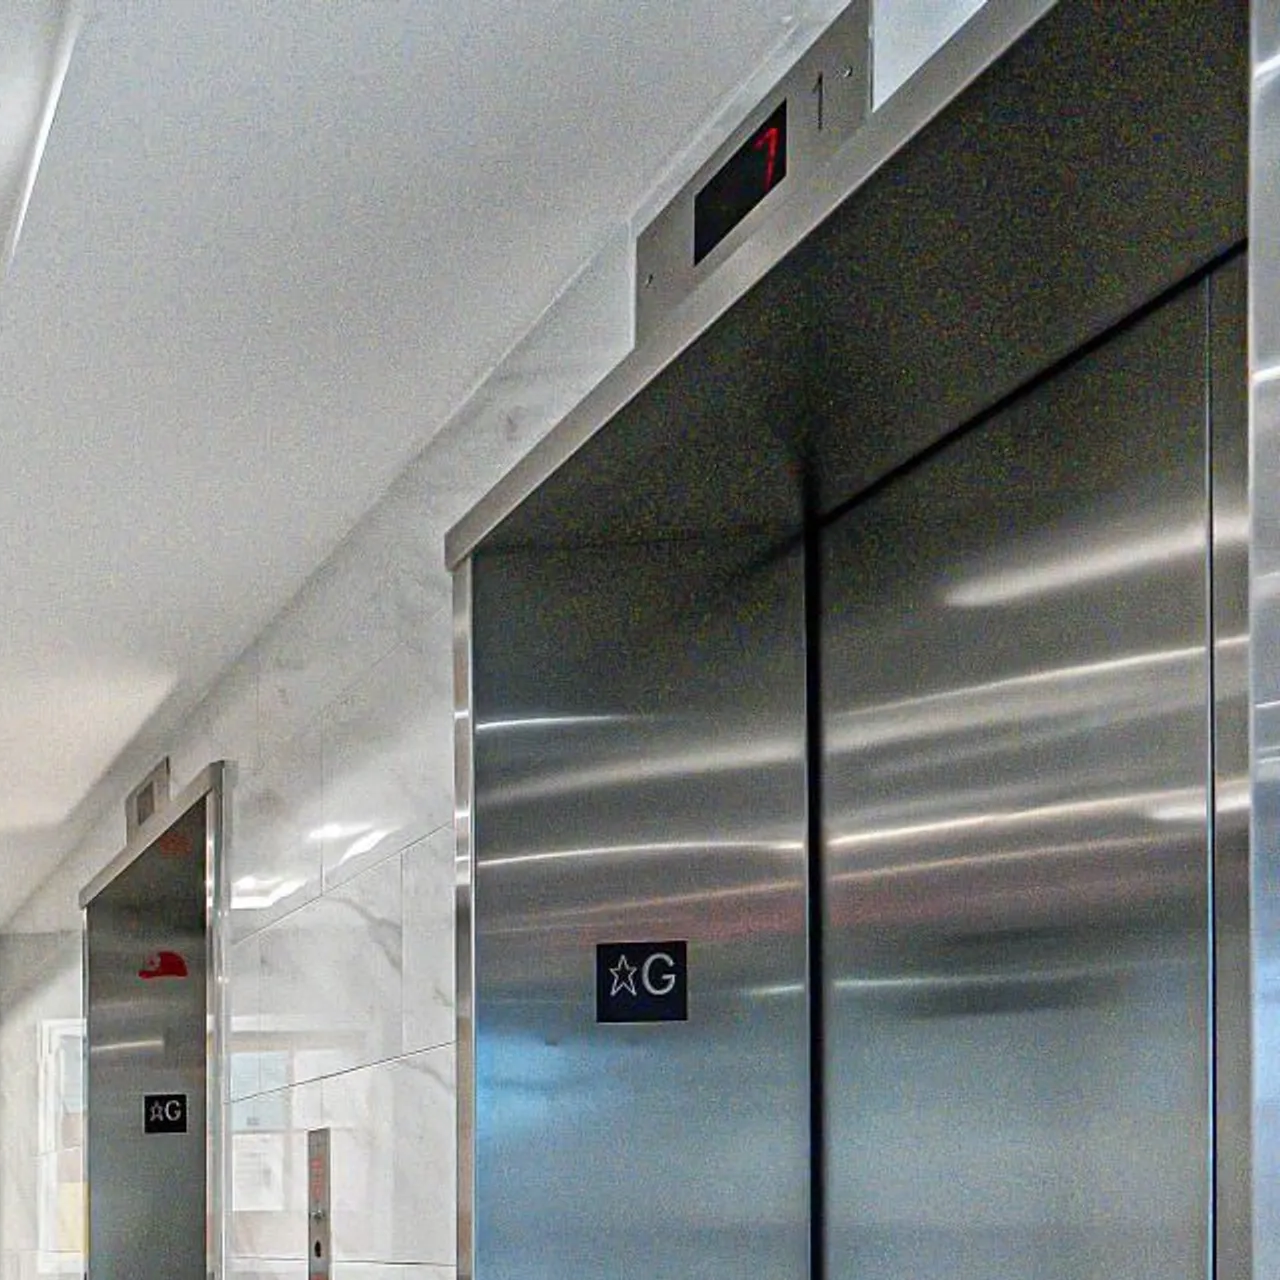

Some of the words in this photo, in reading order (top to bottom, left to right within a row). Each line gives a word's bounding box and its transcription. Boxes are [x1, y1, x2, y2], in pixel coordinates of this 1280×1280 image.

[811, 72, 824, 130] 1
[641, 952, 676, 996] G
[164, 1099, 182, 1122] G
